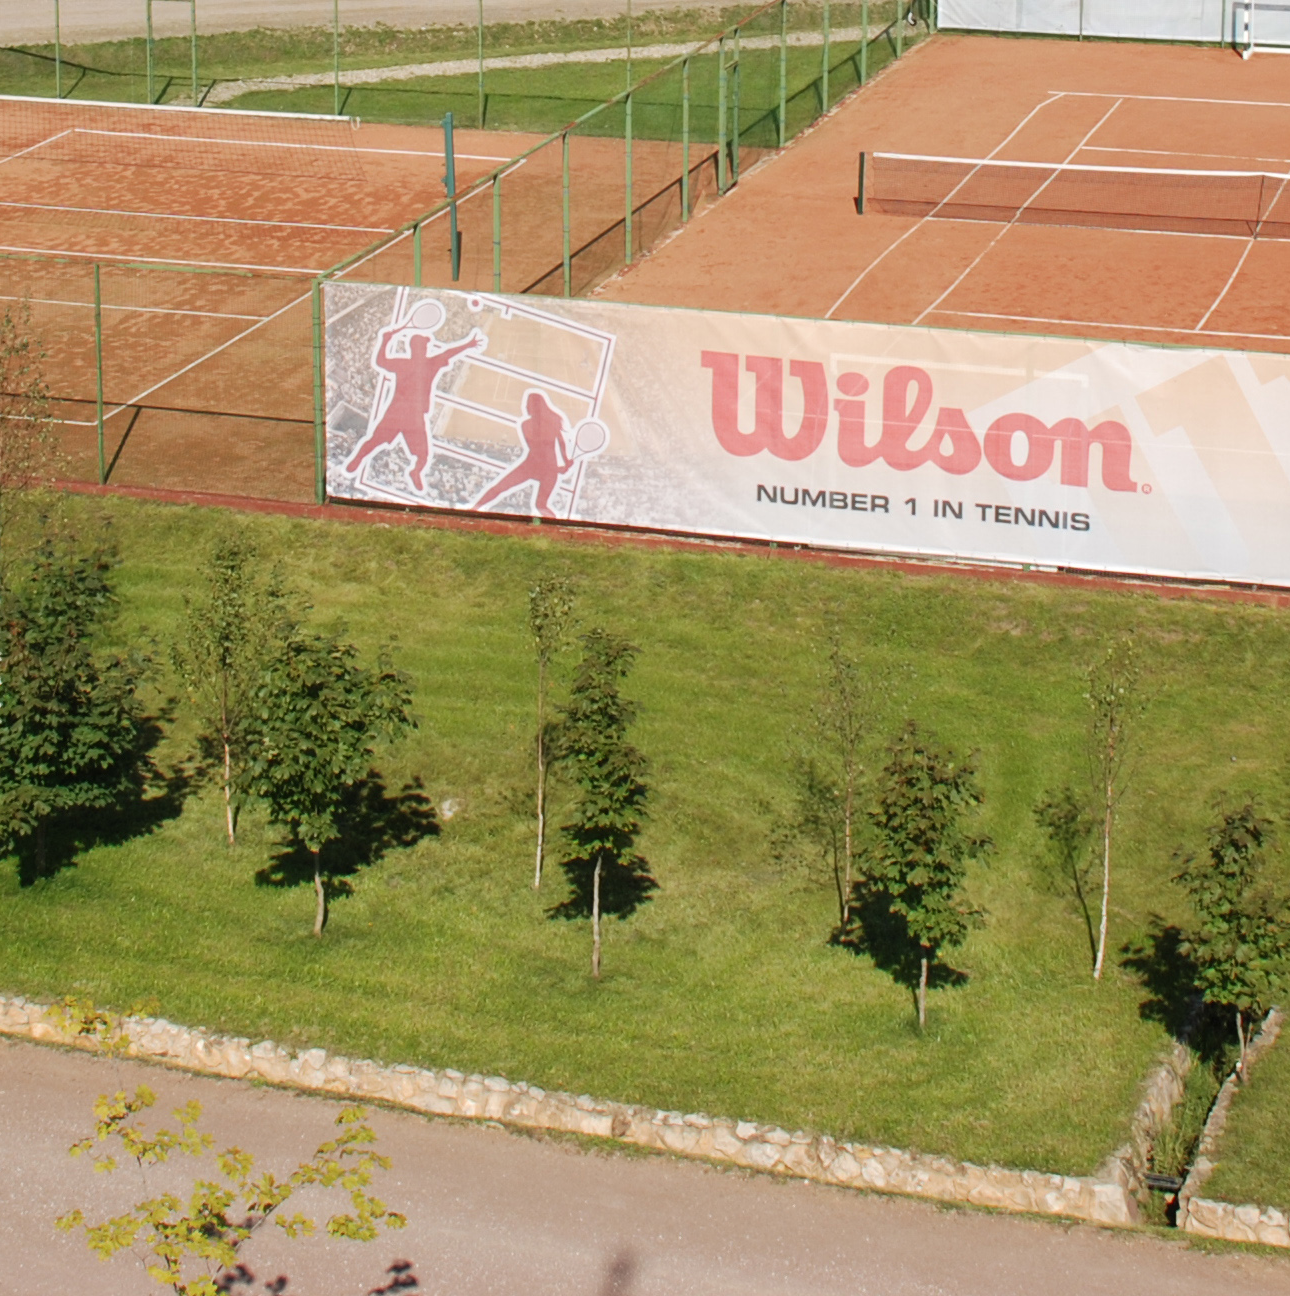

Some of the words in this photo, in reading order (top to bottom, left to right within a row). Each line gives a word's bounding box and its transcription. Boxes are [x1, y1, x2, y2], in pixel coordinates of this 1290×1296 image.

[700, 349, 1139, 494] Wilson
[756, 483, 890, 514] NUMBER
[904, 497, 917, 516] 1
[933, 499, 964, 520] IN
[974, 502, 1092, 532] TENNIS
